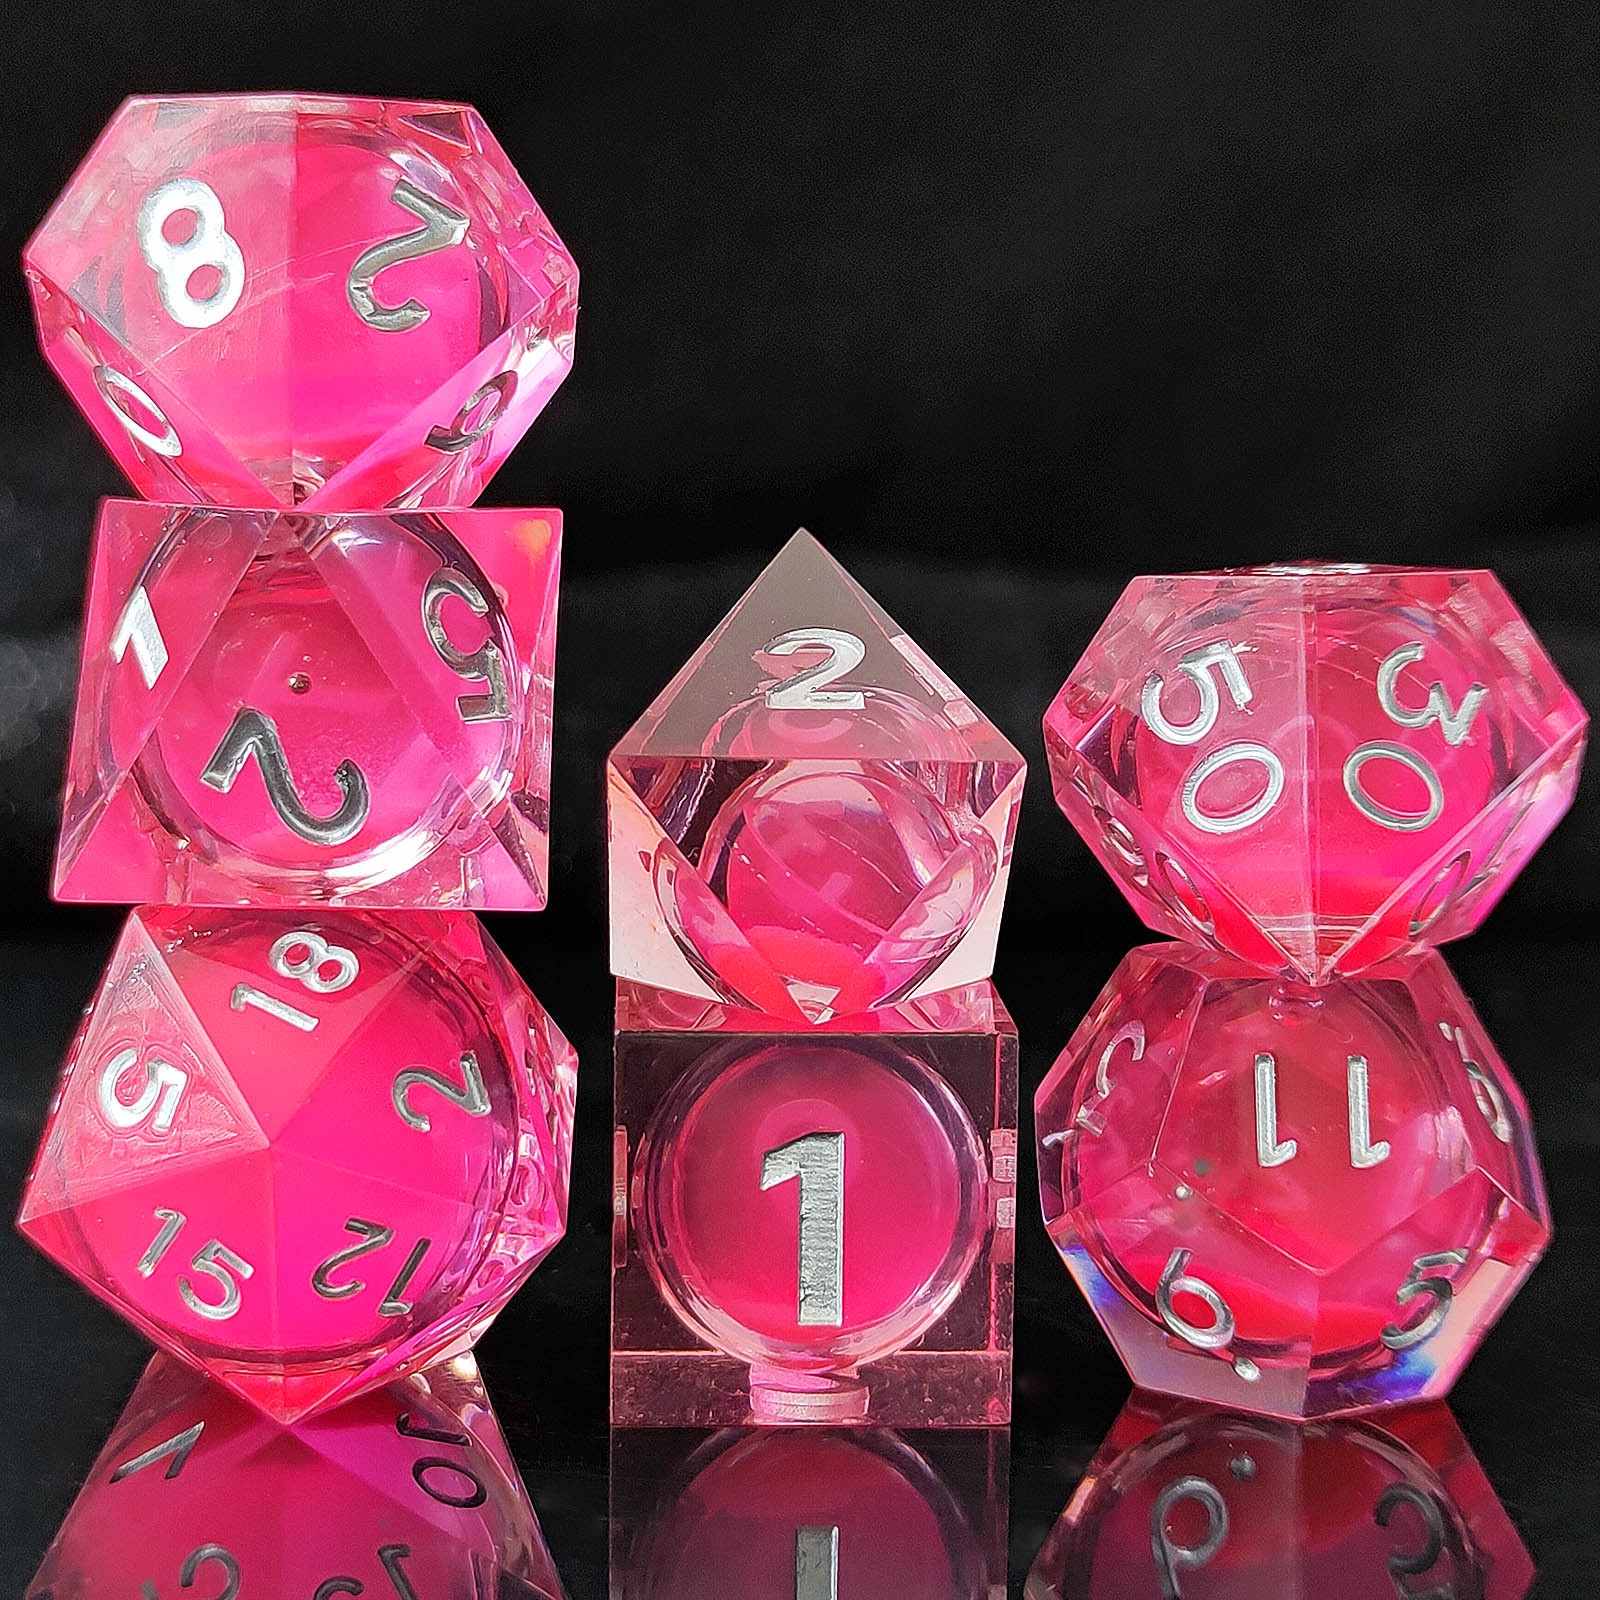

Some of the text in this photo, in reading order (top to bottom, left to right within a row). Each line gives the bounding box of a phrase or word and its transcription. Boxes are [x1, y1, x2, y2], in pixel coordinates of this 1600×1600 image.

[136, 177, 246, 329] 8
[347, 177, 470, 333] 2
[92, 363, 183, 458] 0
[423, 564, 514, 724] 5
[763, 627, 867, 710] 2
[200, 705, 370, 847] 2
[1141, 638, 1286, 836] 50
[1343, 641, 1490, 833] 30
[230, 930, 361, 1033] 18
[97, 1047, 191, 1133] 5
[391, 1050, 492, 1134] 2
[1253, 1052, 1391, 1169] 11
[137, 1207, 255, 1321] 15
[311, 1217, 431, 1318] 12
[760, 1130, 846, 1328] 1
[1381, 1246, 1470, 1351] 5
